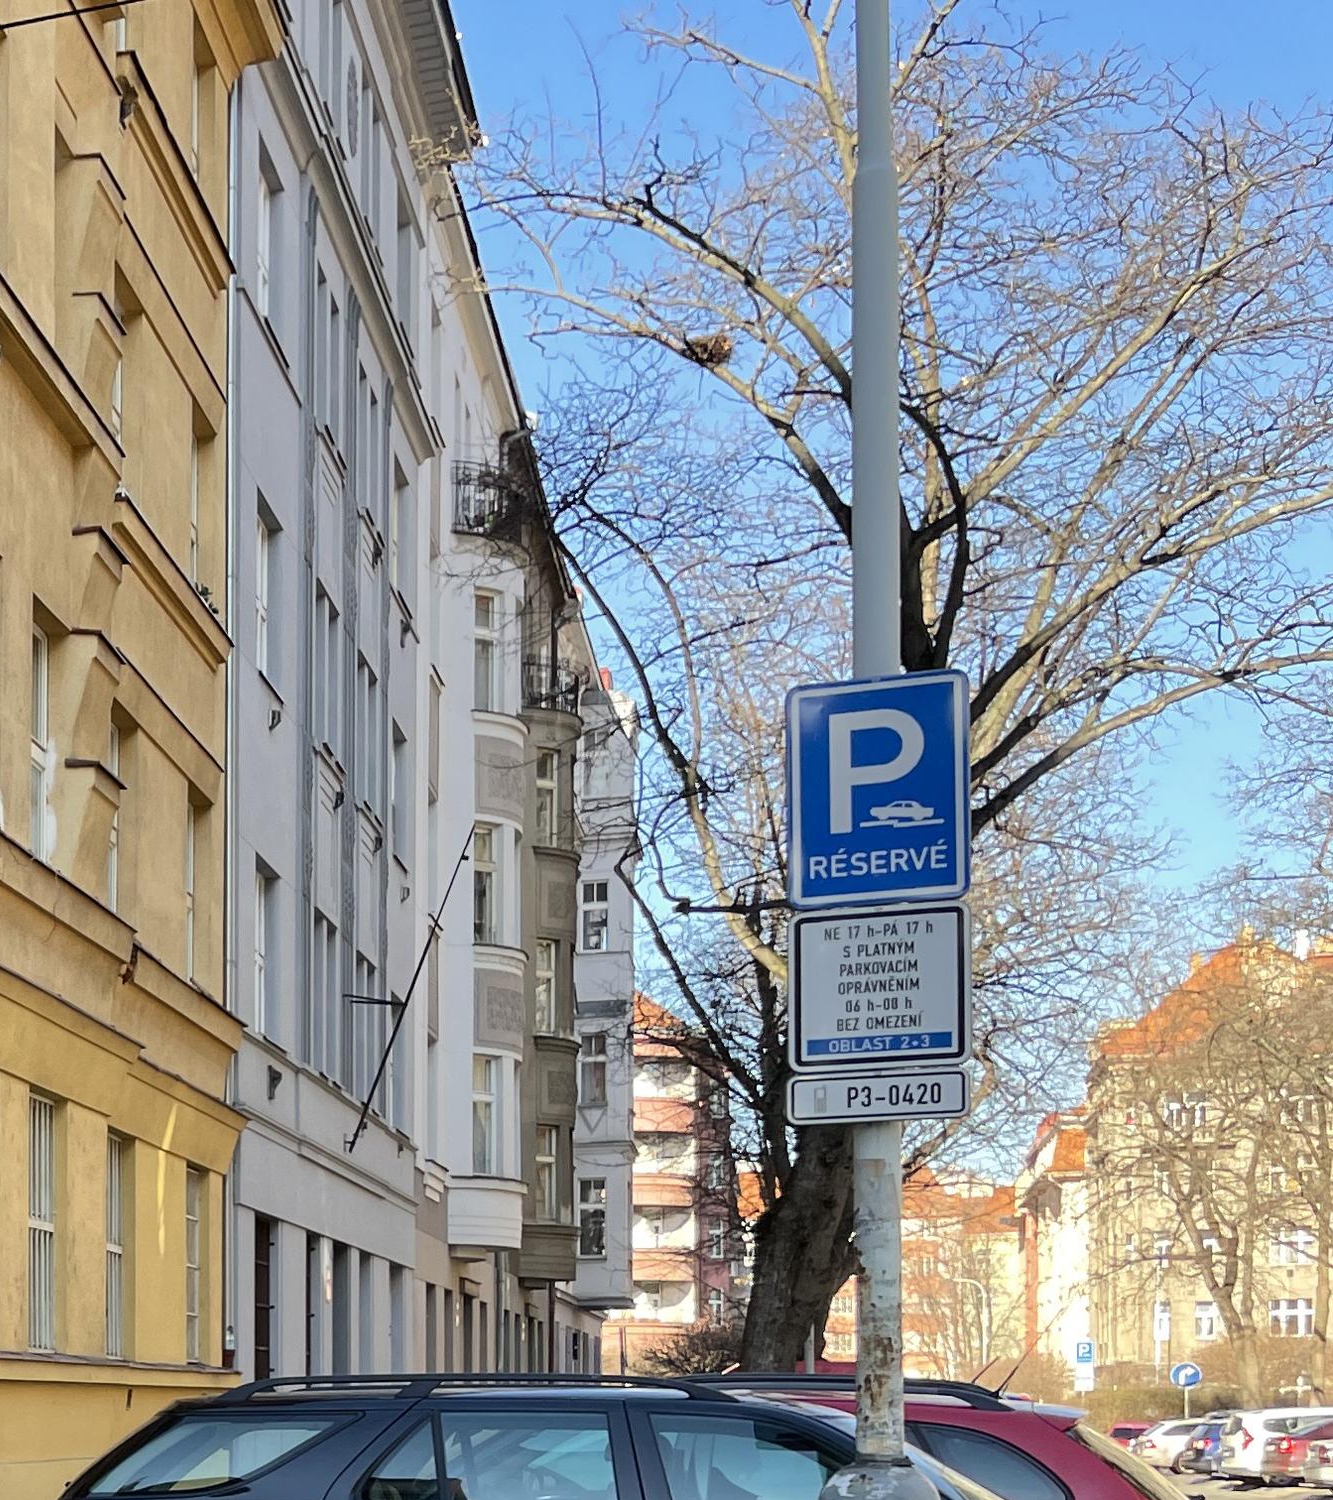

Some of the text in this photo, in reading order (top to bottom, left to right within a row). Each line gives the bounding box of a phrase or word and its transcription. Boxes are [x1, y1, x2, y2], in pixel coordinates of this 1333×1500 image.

[828, 708, 925, 835] P
[809, 838, 948, 880] RÉSERVÉ
[824, 927, 841, 941] NE
[848, 926, 860, 939] 17
[906, 921, 919, 935] 17
[925, 920, 933, 934] h
[843, 938, 915, 958] S PLATNÝM
[839, 957, 918, 977] PARKOVACÍM
[838, 976, 920, 995] OPRÁVNĚNÍM
[845, 1000, 861, 1013] 06
[904, 996, 912, 1009] h
[836, 1010, 924, 1032] BEZ OMEZENÍ
[828, 1036, 893, 1053] OBLAST
[847, 1082, 942, 1108] P3-0420
